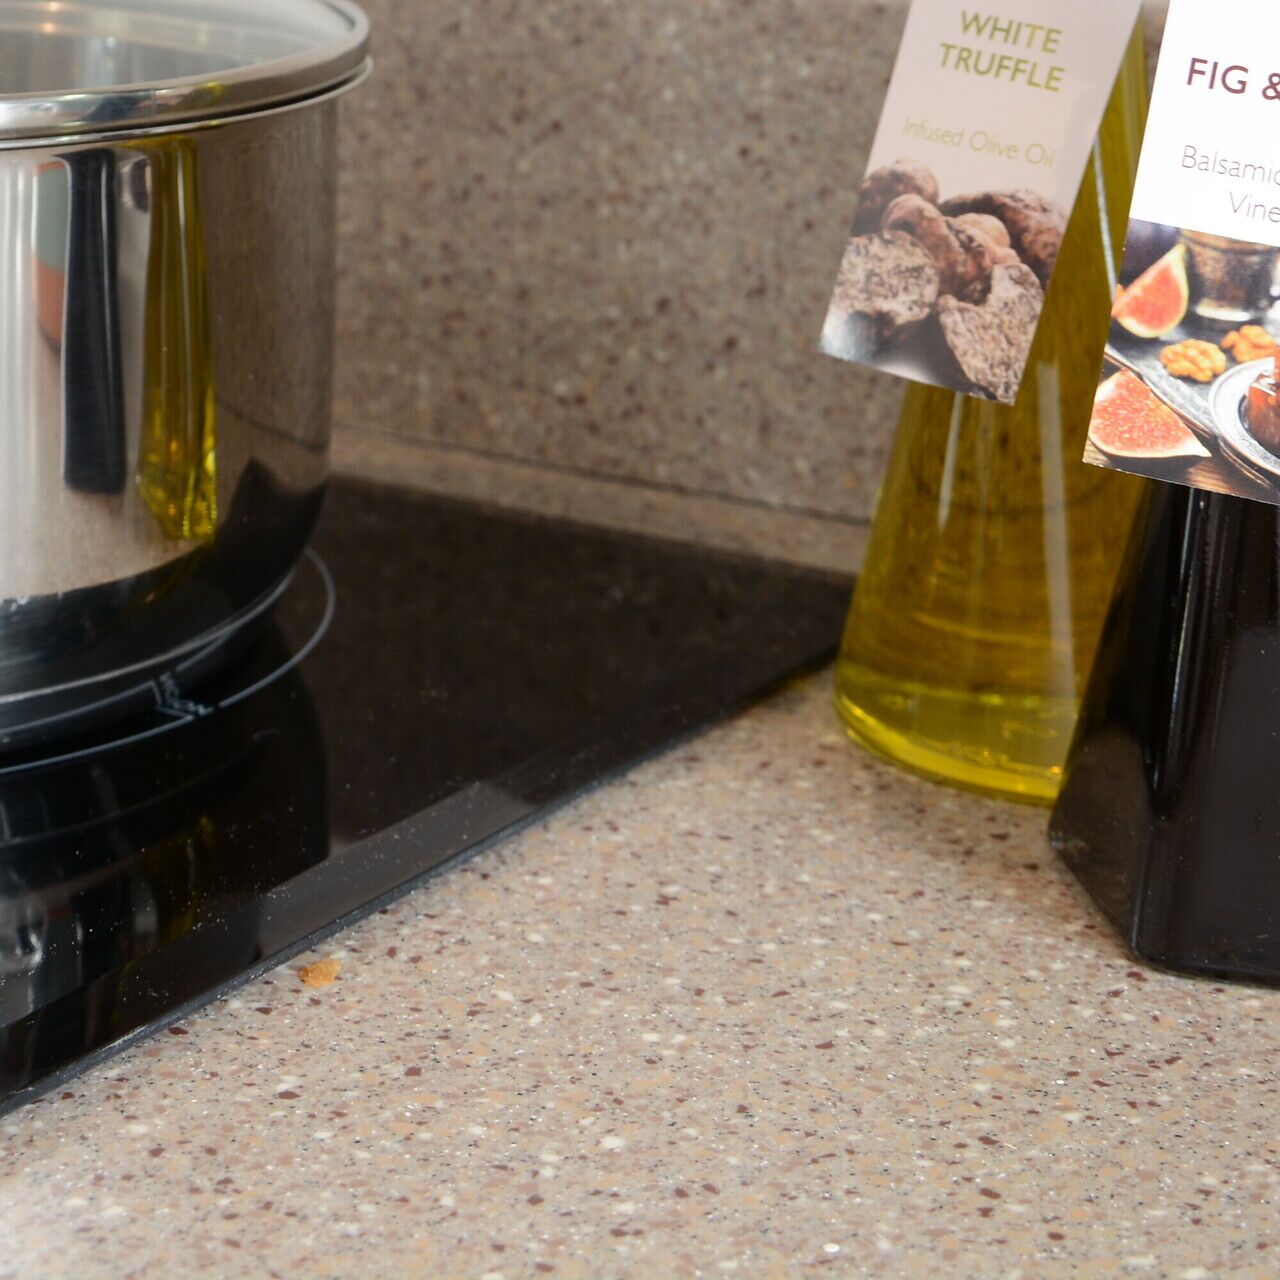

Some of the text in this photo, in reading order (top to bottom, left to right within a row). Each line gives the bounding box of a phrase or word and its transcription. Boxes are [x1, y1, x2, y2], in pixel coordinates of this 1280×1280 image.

[961, 10, 1063, 55] WHITE
[939, 42, 1065, 92] TRUFFLE
[1186, 57, 1249, 94] FIG
[902, 117, 1057, 167] Infused Olive Oil
